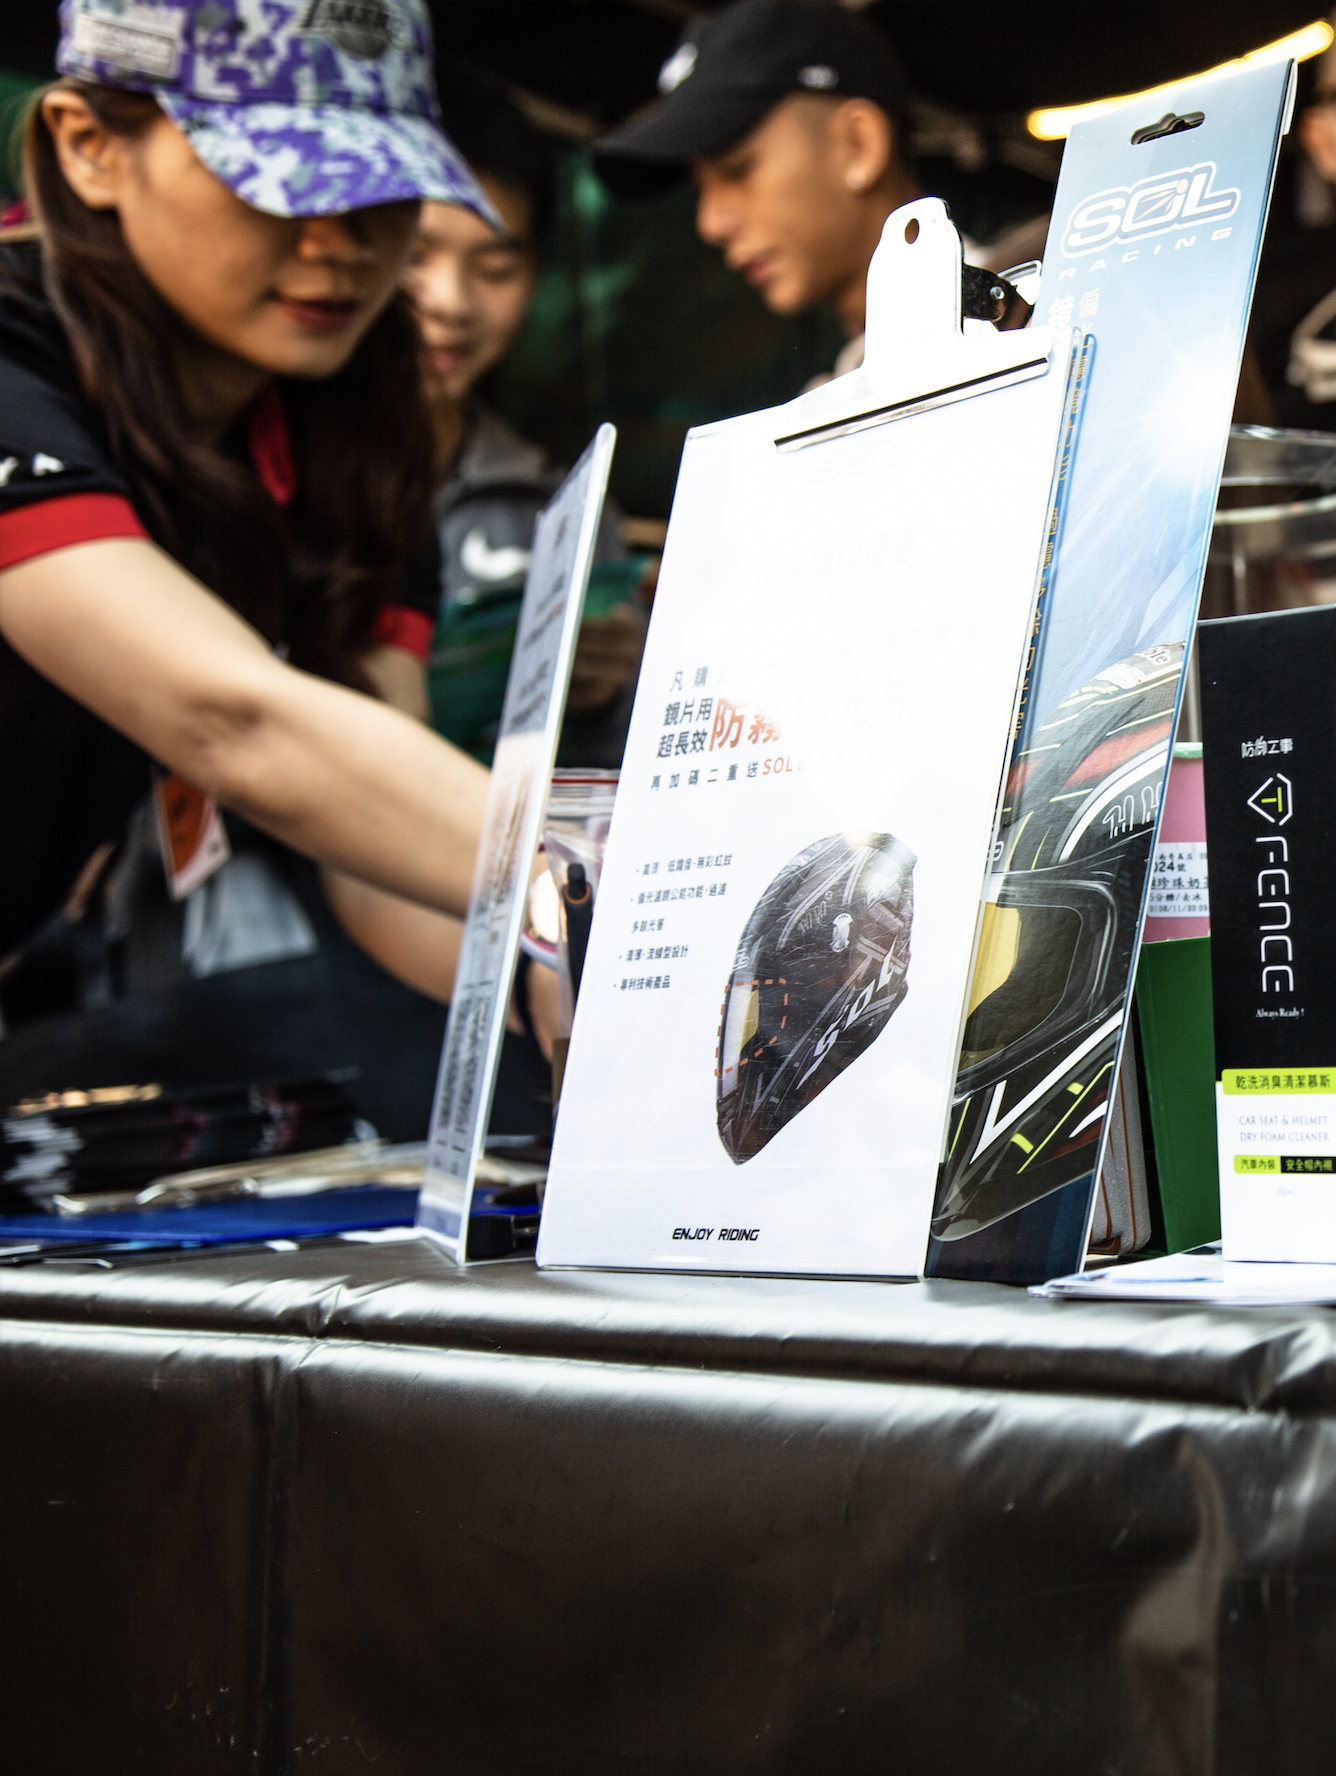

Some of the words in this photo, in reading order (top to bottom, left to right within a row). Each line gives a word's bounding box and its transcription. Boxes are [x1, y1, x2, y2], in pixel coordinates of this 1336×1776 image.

[1060, 160, 1241, 259] SOL
[1058, 227, 1233, 281] RACING
[662, 698, 714, 727] 鏡片用
[656, 730, 708, 759] 超長效
[1256, 1007, 1279, 1018] Always
[1279, 1006, 1299, 1018] Ready
[1235, 1074, 1330, 1090] 乾洗消臭清潔慕斯
[1239, 1116, 1257, 1126] CAR
[1260, 1116, 1279, 1126] SEAT
[1282, 1115, 1289, 1126] &
[1292, 1116, 1328, 1126] HELMET
[1240, 1132, 1257, 1142] DRY
[1260, 1132, 1286, 1142] FOAM
[1288, 1132, 1329, 1142] CLEANER
[672, 1228, 714, 1240] ENJOY
[718, 1228, 760, 1241] RIDING
